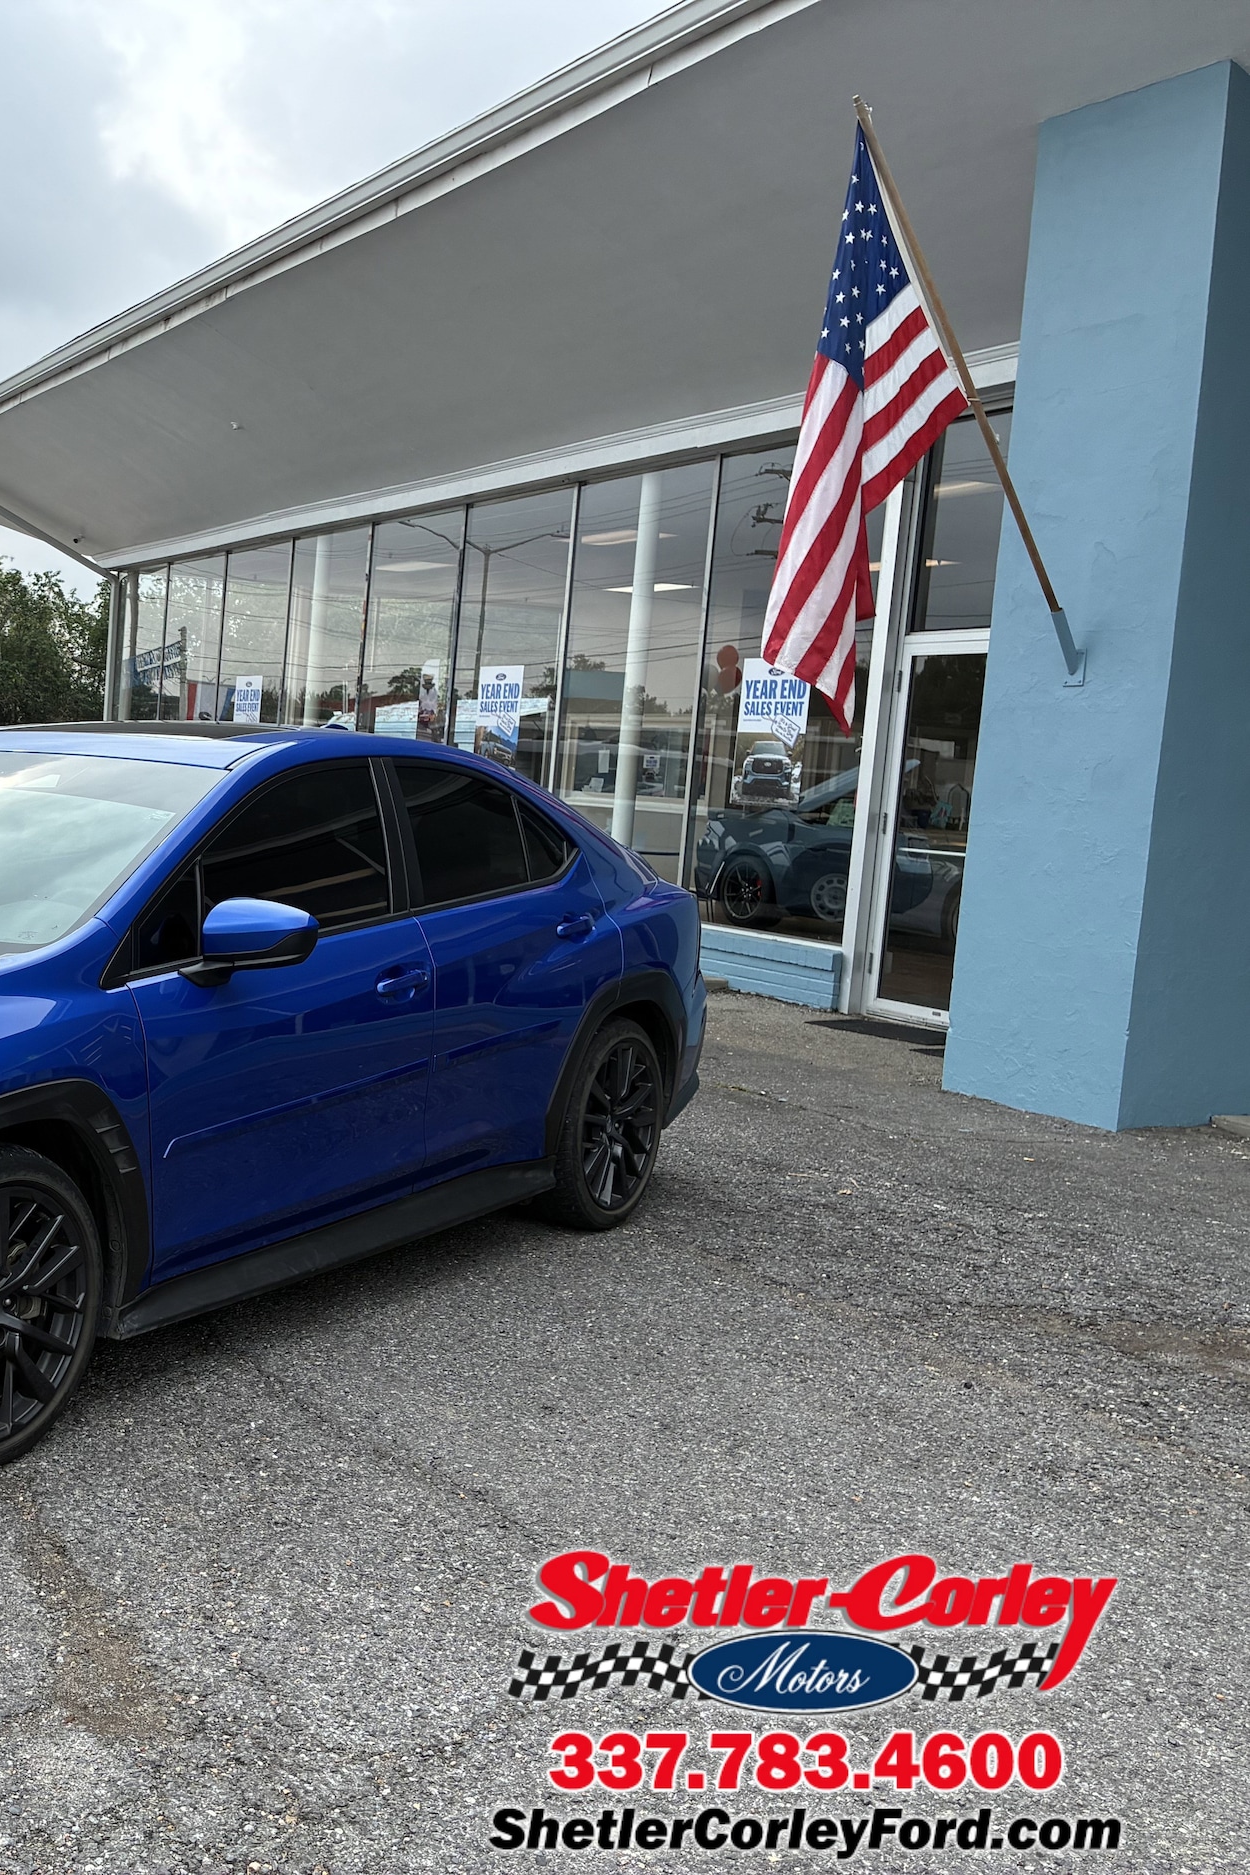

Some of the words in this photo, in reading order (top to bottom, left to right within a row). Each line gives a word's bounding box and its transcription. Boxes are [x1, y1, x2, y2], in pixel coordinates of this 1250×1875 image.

[236, 689, 249, 702] YEAR
[250, 689, 260, 702] END
[481, 684, 502, 700] YEAR
[503, 683, 520, 699] END
[745, 680, 778, 699] YEAR
[780, 680, 807, 699] END
[236, 702, 247, 712] SALES
[247, 702, 259, 712] EVENT
[480, 701, 498, 713] SALES
[499, 701, 519, 713] EVENT
[744, 701, 773, 716] SALES
[774, 701, 804, 716] EVENT
